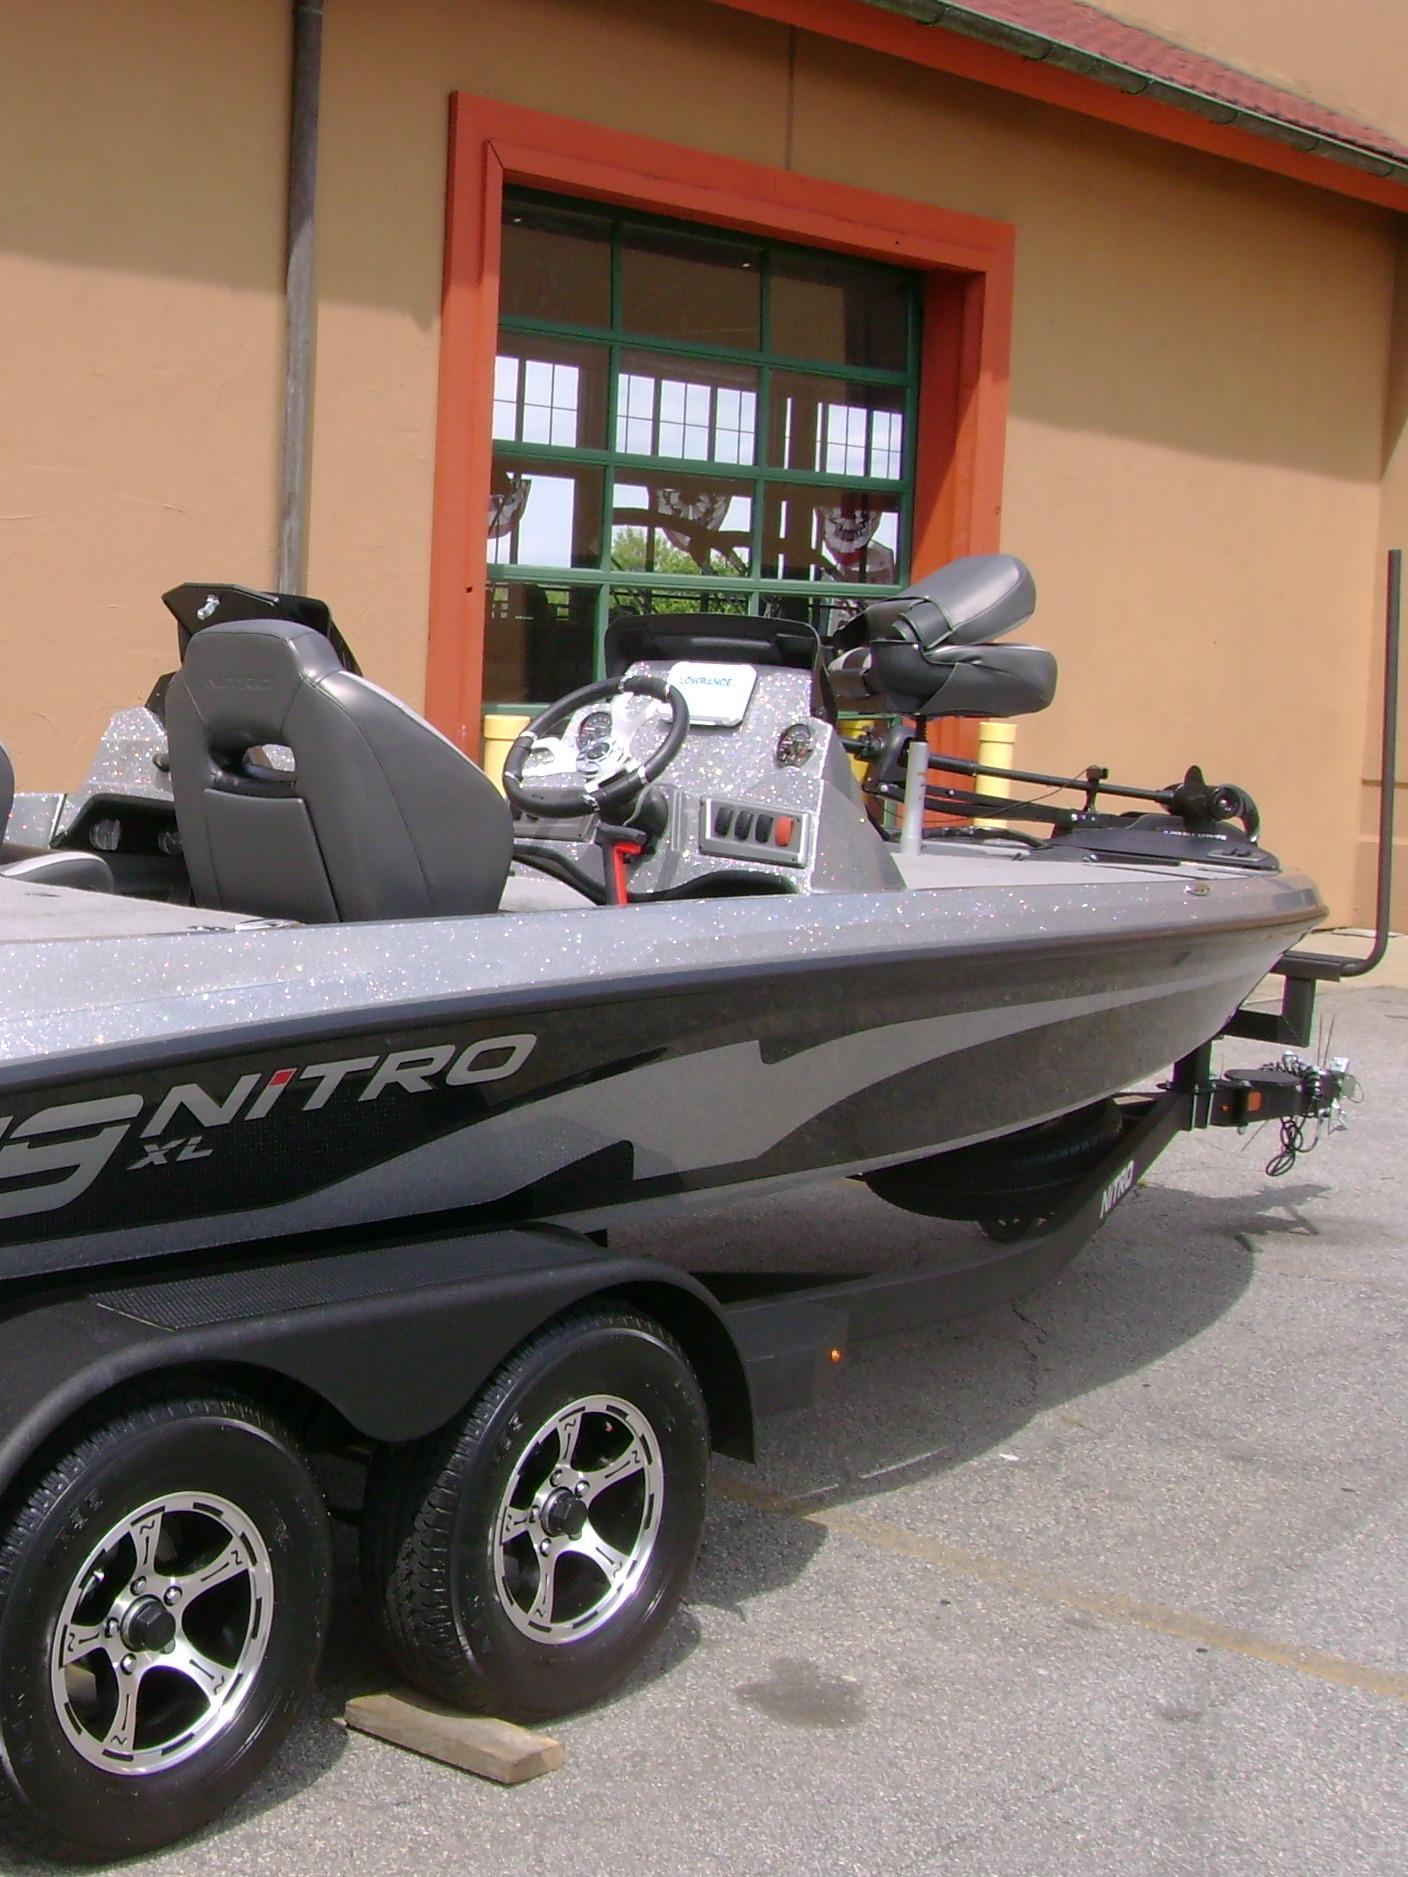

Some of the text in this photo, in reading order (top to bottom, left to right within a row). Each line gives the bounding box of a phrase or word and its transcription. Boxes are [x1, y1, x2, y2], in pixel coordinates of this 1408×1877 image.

[679, 676, 733, 687] LOWRANCE
[140, 1034, 537, 1139] NITRO
[127, 1135, 214, 1171] XL
[1099, 1160, 1135, 1219] NITRO
